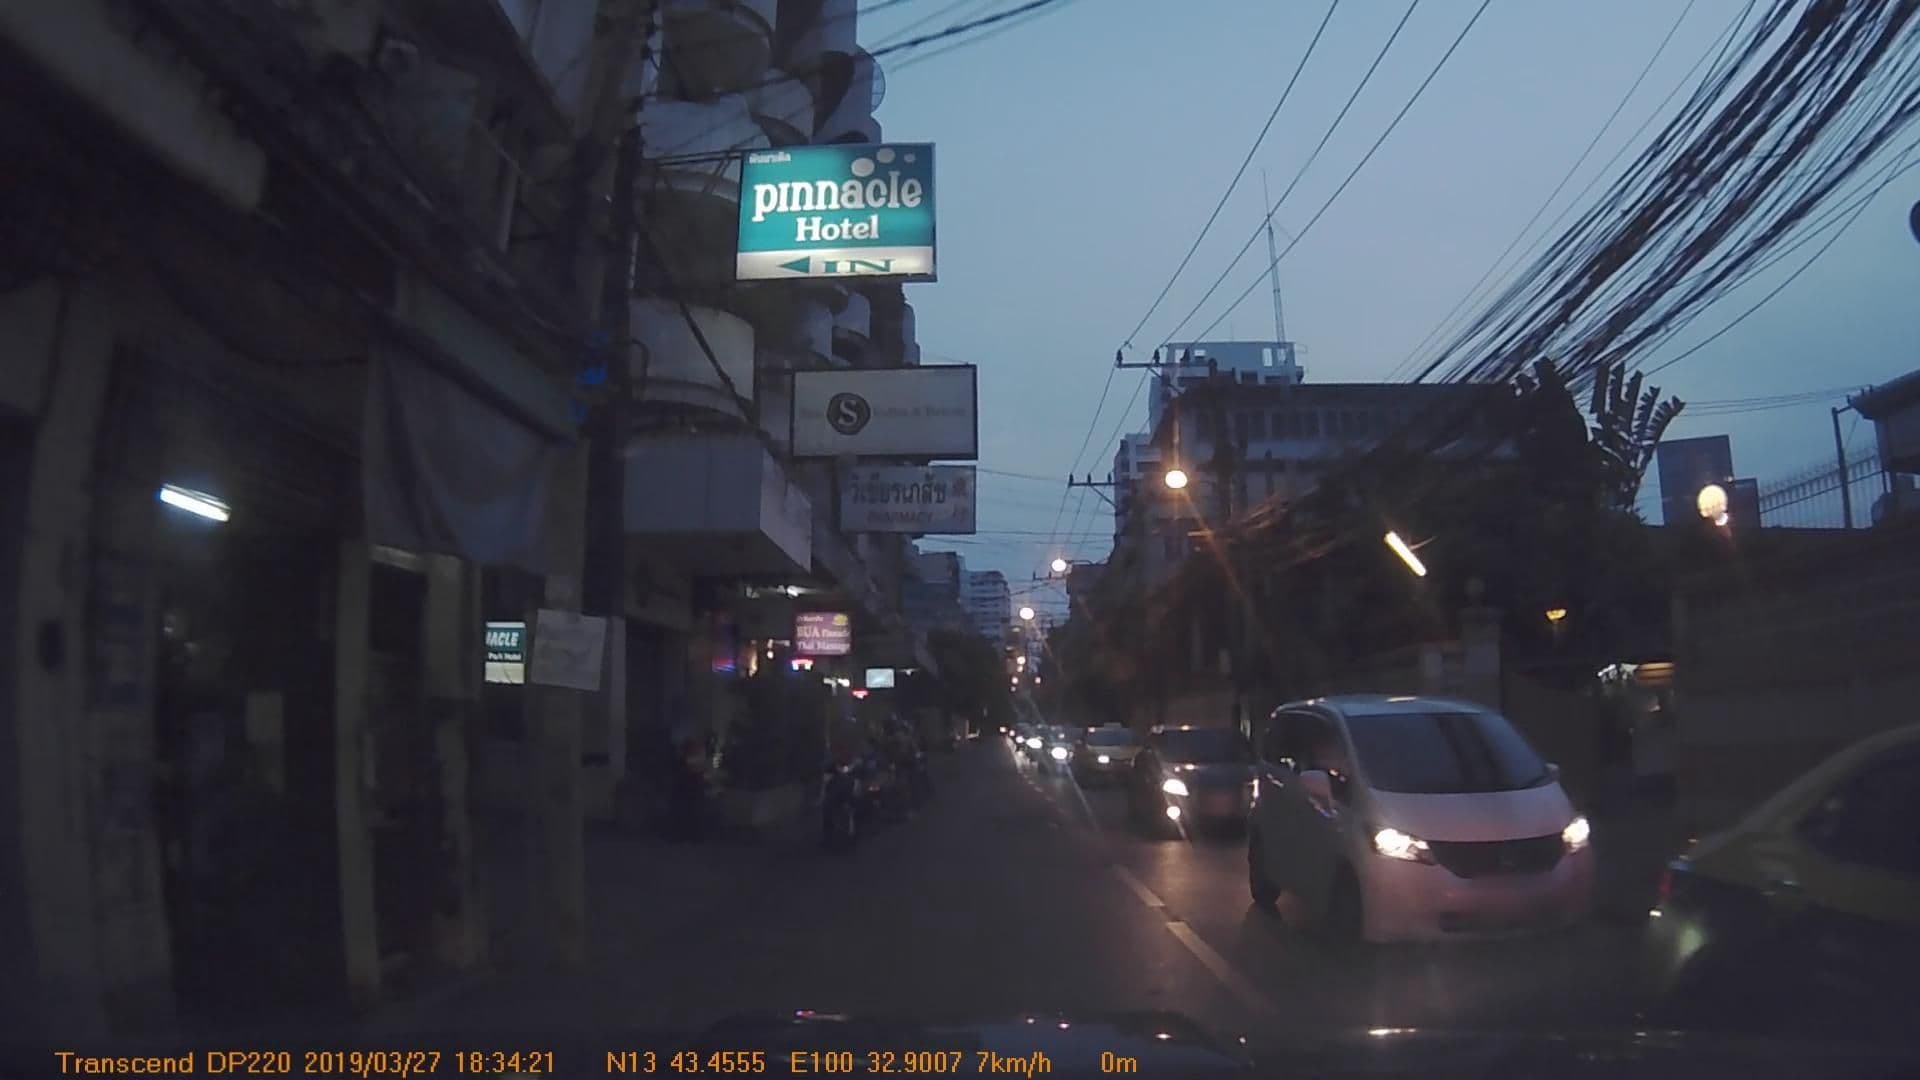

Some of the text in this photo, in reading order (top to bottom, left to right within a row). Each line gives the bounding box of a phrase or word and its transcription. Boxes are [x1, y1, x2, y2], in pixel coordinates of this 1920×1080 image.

[751, 171, 923, 222] pinnacle
[795, 214, 879, 241] Hotel
[824, 259, 893, 273] IN
[837, 398, 859, 425] S
